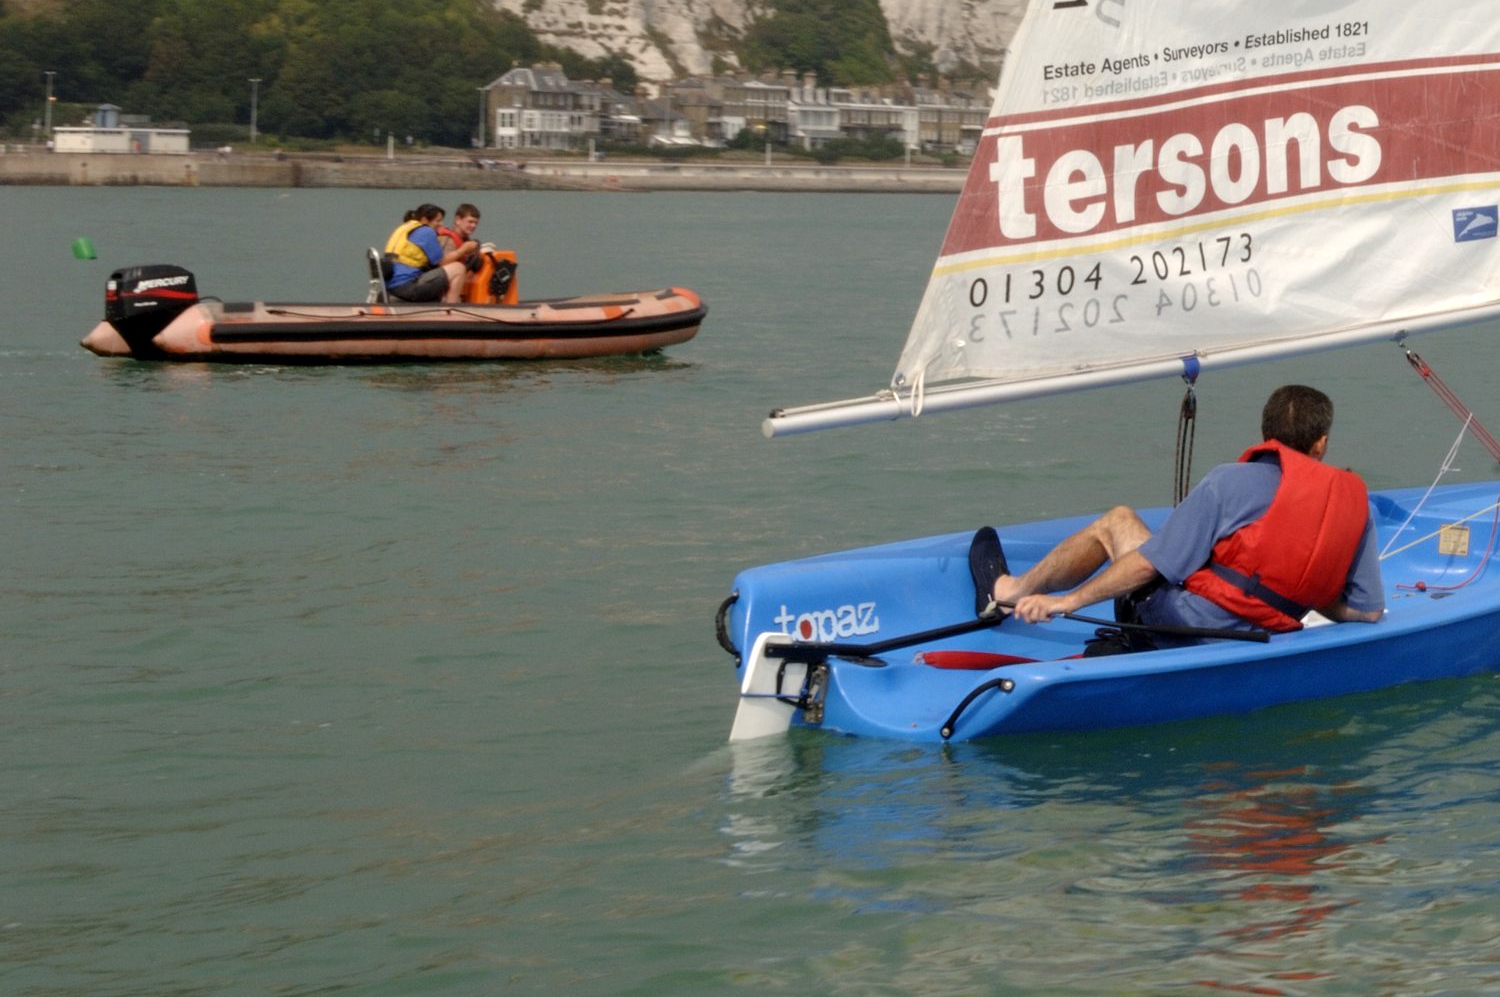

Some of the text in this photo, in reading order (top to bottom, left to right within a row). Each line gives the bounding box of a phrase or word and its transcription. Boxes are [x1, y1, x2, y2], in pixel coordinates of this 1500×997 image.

[1043, 21, 1369, 81] Estate Agents Surveyors Established 1821
[988, 104, 1382, 239] tersons
[969, 232, 1253, 307] 01304 202173
